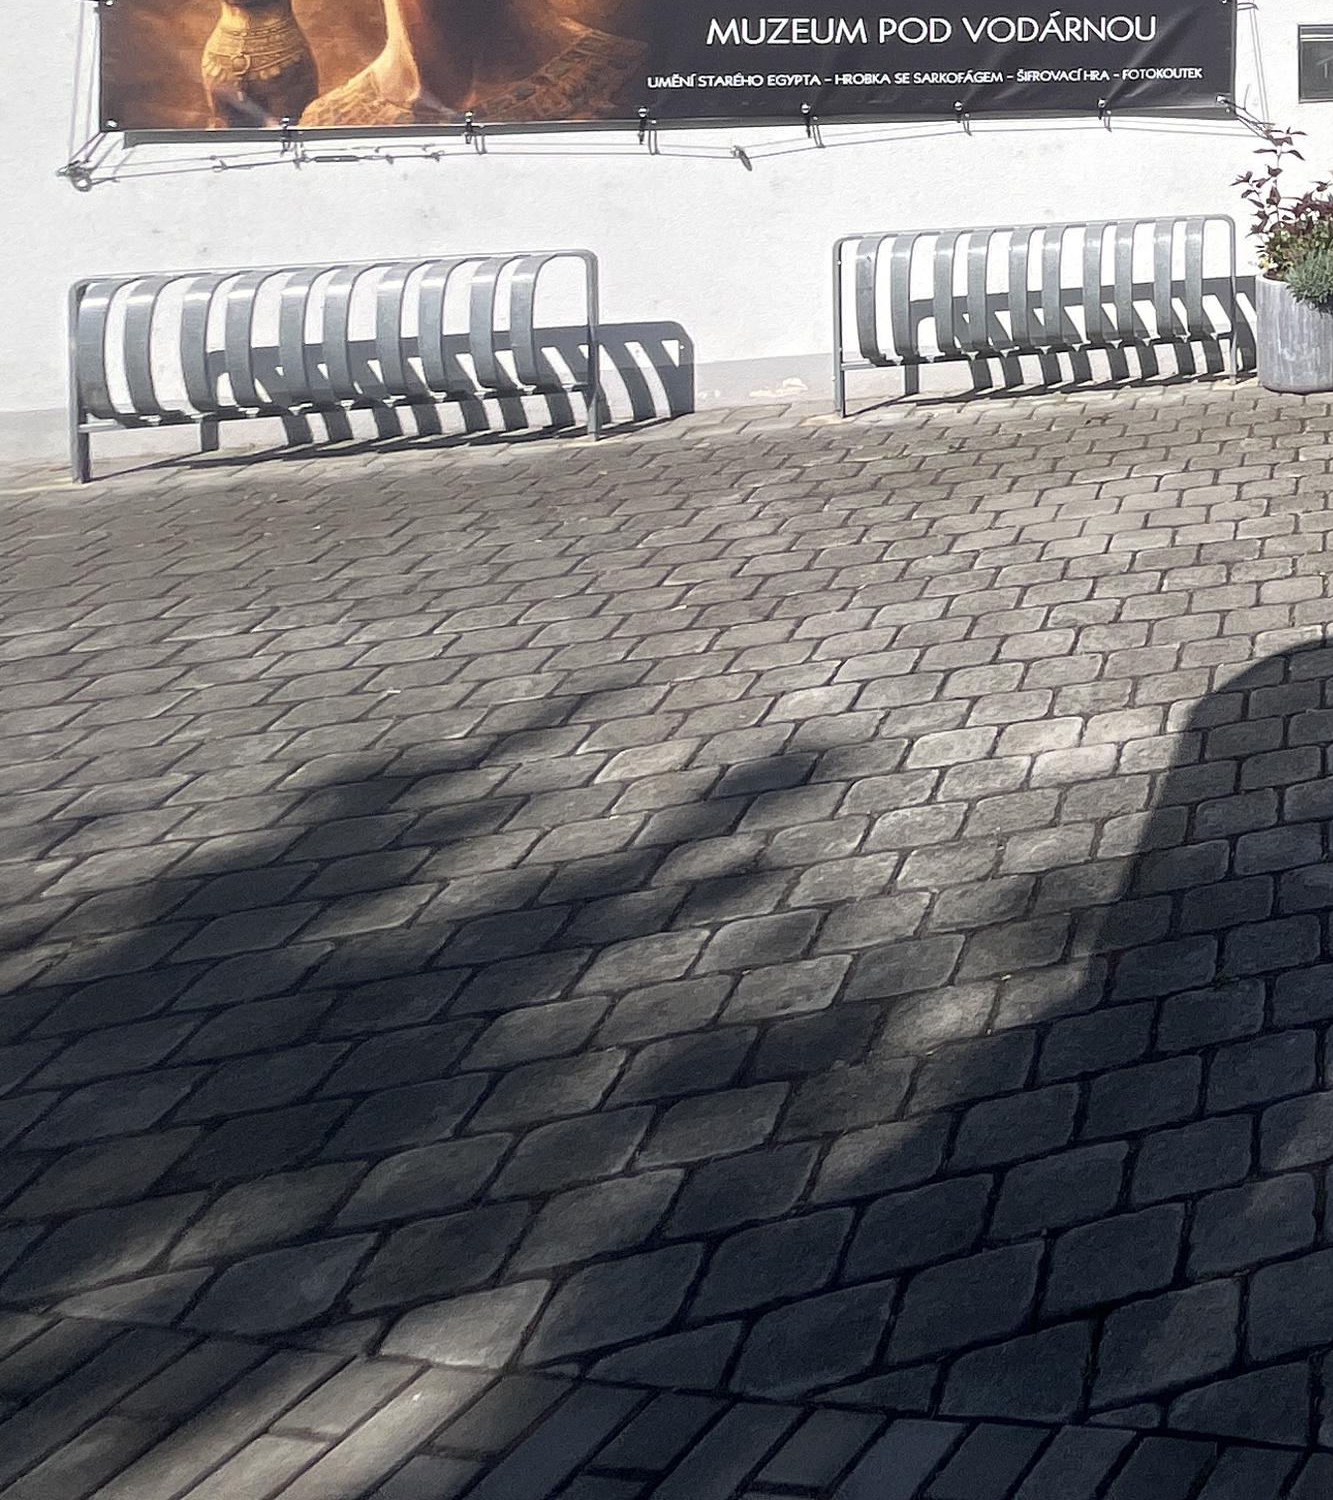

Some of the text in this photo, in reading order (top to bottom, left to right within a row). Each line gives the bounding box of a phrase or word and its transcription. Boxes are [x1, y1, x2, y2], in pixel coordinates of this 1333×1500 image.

[706, 10, 1156, 45] MUZEUM POD VODÁRNOU
[647, 73, 695, 88] UMĚNÍ
[698, 72, 764, 87] STARÉHO
[766, 73, 822, 87] EGYPTA
[834, 72, 892, 86] HROBKA
[894, 72, 911, 85] SE
[913, 68, 1004, 85] SARKOFÁGEM
[1016, 67, 1082, 83] ŠIFROVACÍ
[1083, 70, 1111, 82] HRA
[1121, 67, 1203, 81] FOTOKOUTEK
